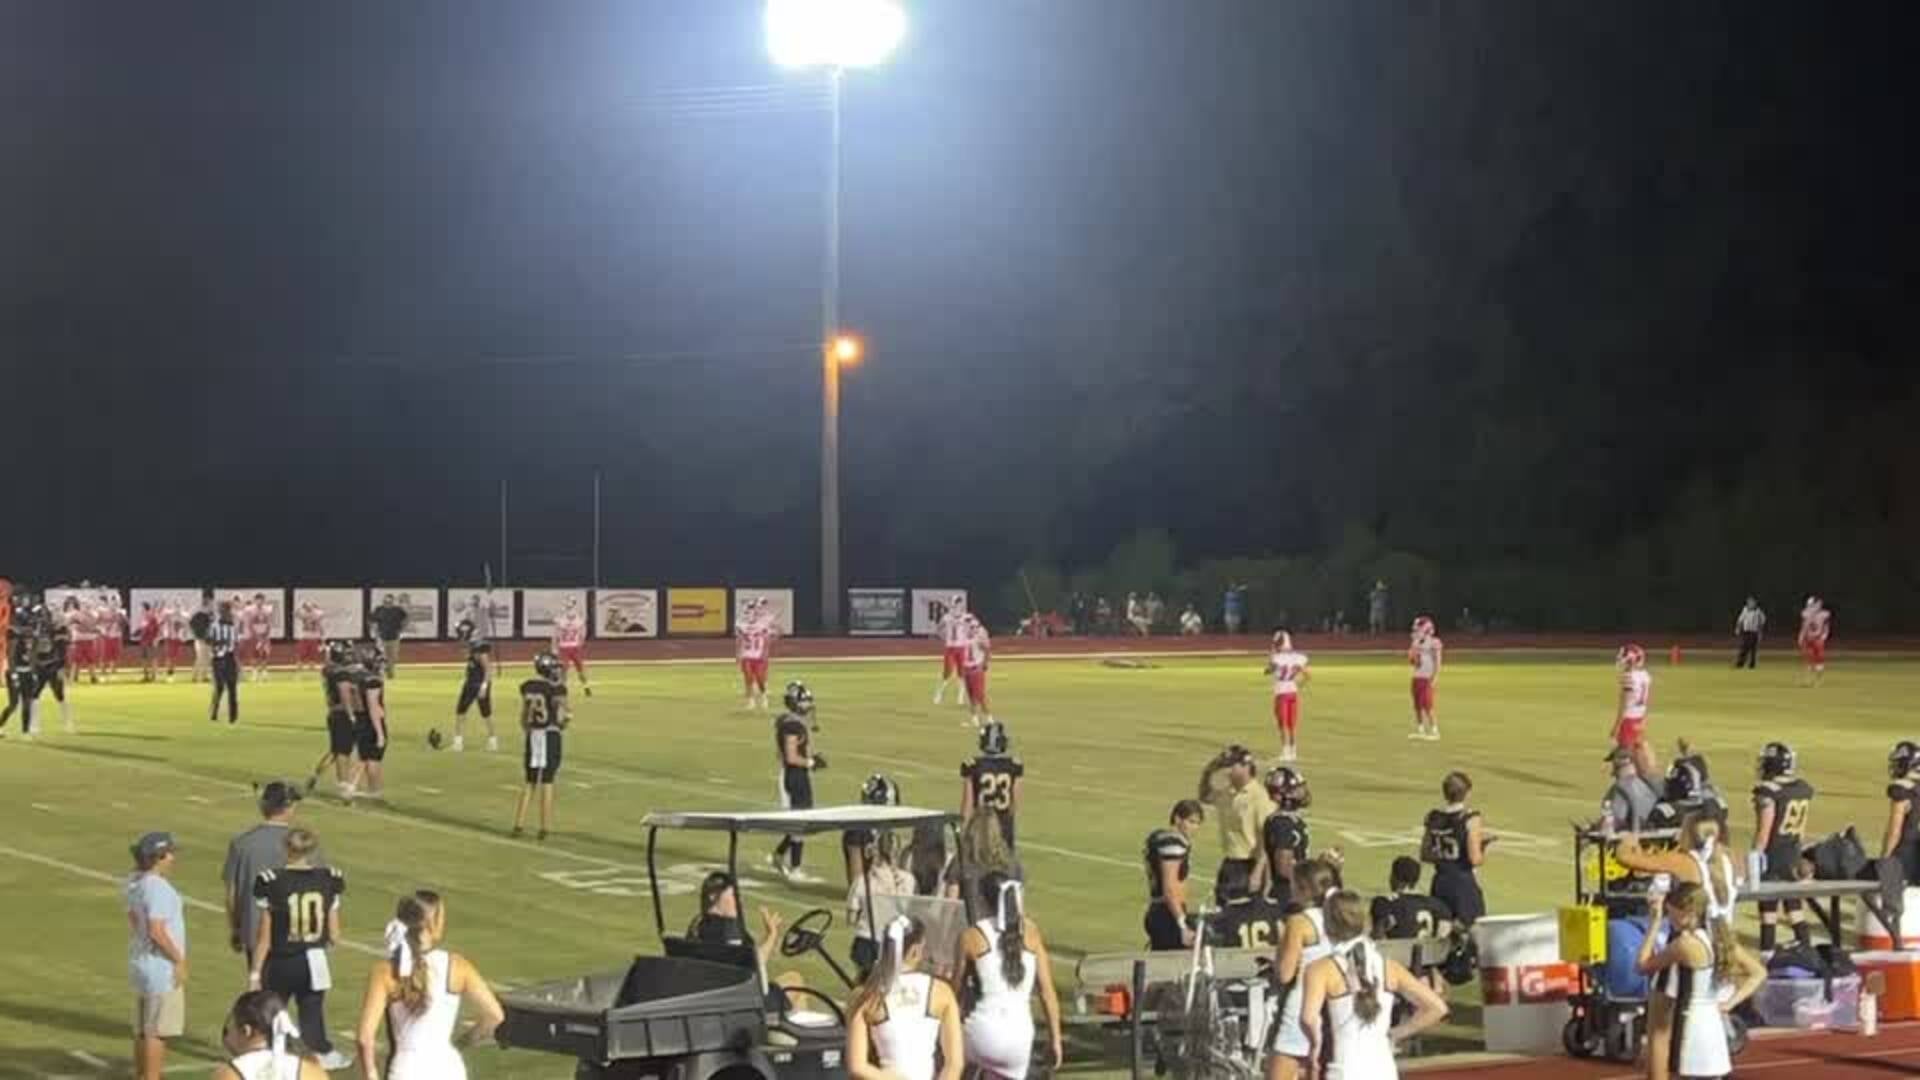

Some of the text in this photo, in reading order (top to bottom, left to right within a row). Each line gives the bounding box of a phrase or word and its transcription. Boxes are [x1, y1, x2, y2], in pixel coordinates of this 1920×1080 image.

[979, 772, 1011, 810] 23
[288, 892, 324, 942] 10
[1238, 920, 1271, 949] 16
